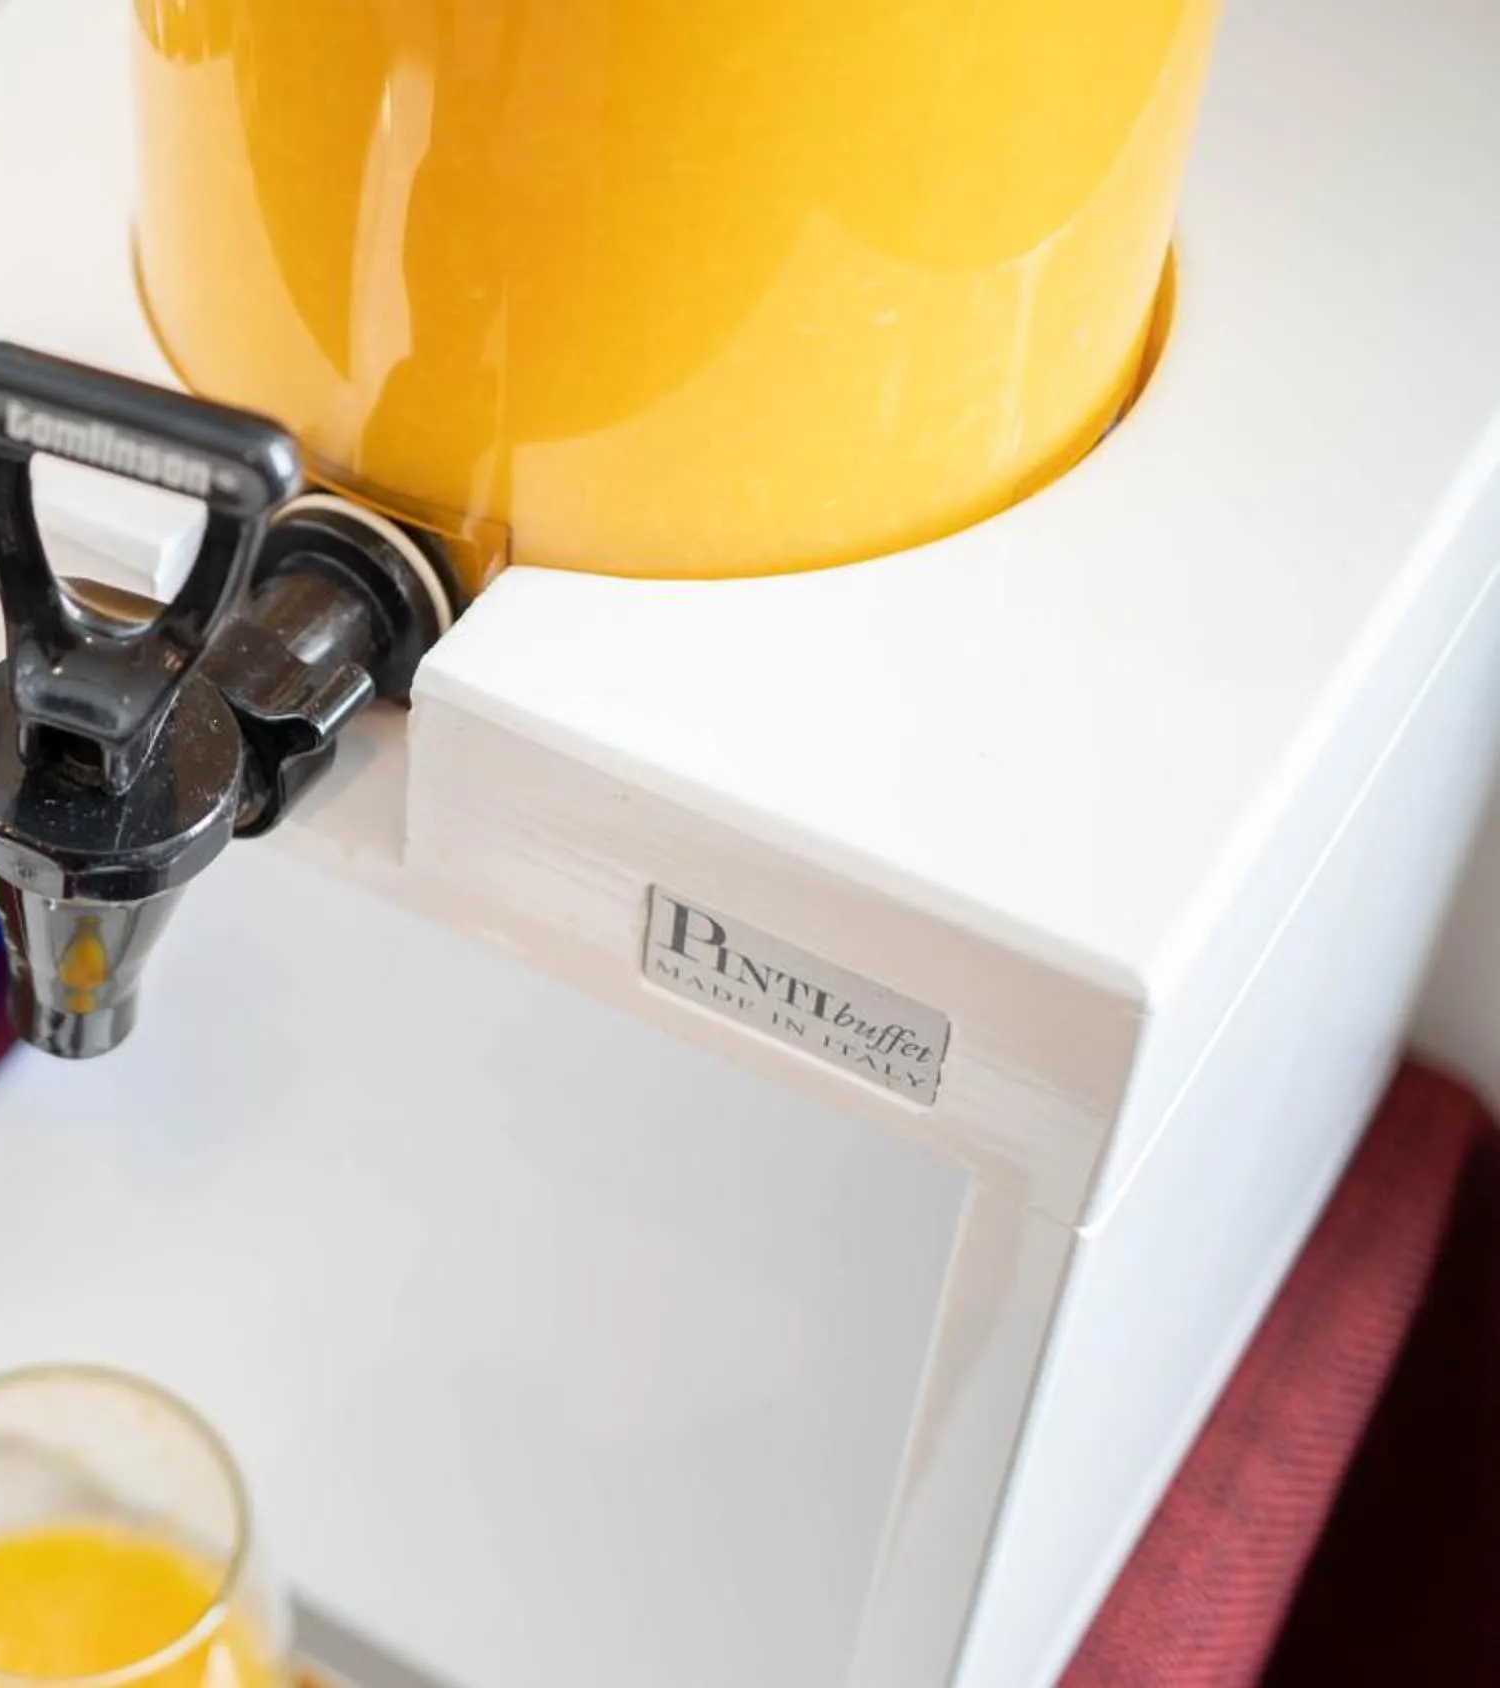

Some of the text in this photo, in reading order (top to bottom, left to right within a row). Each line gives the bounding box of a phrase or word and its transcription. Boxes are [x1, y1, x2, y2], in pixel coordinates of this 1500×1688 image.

[4, 399, 212, 496] tomlinson
[655, 959, 927, 1088] MADE IN ITALY
